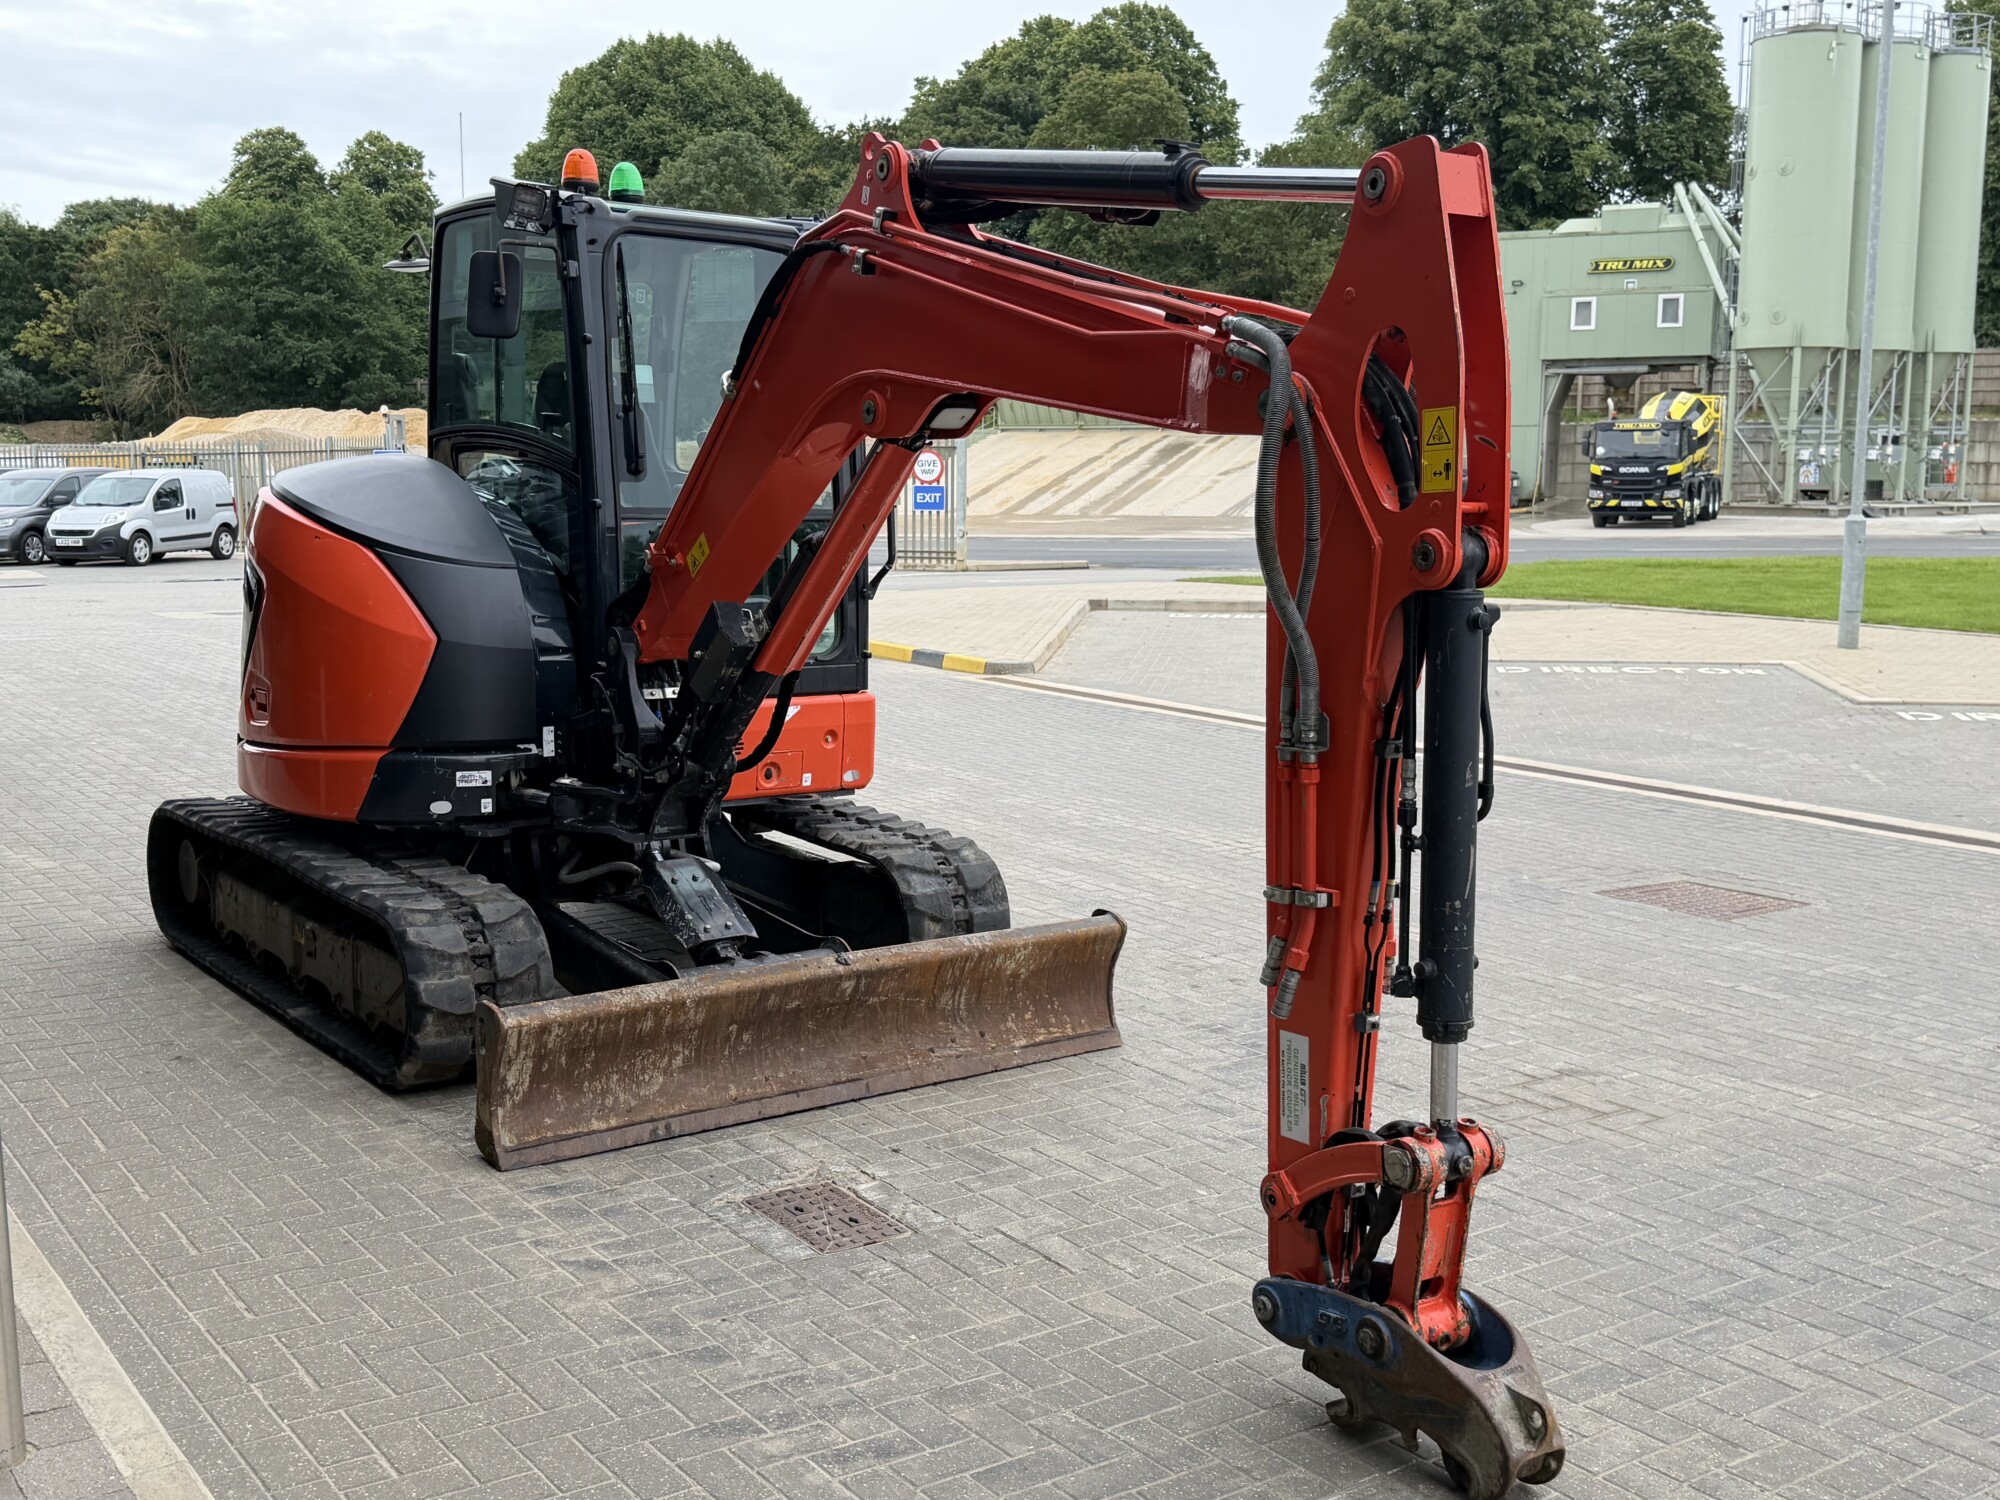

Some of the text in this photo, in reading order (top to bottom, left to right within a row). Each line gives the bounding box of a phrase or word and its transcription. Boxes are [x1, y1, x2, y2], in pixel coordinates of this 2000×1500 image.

[1597, 259, 1667, 270] TRU MIX
[917, 460, 938, 468] GIVE
[1618, 466, 1650, 474] SCANIA
[916, 493, 942, 503] EXIT
[1300, 1088, 1306, 1107] GT
